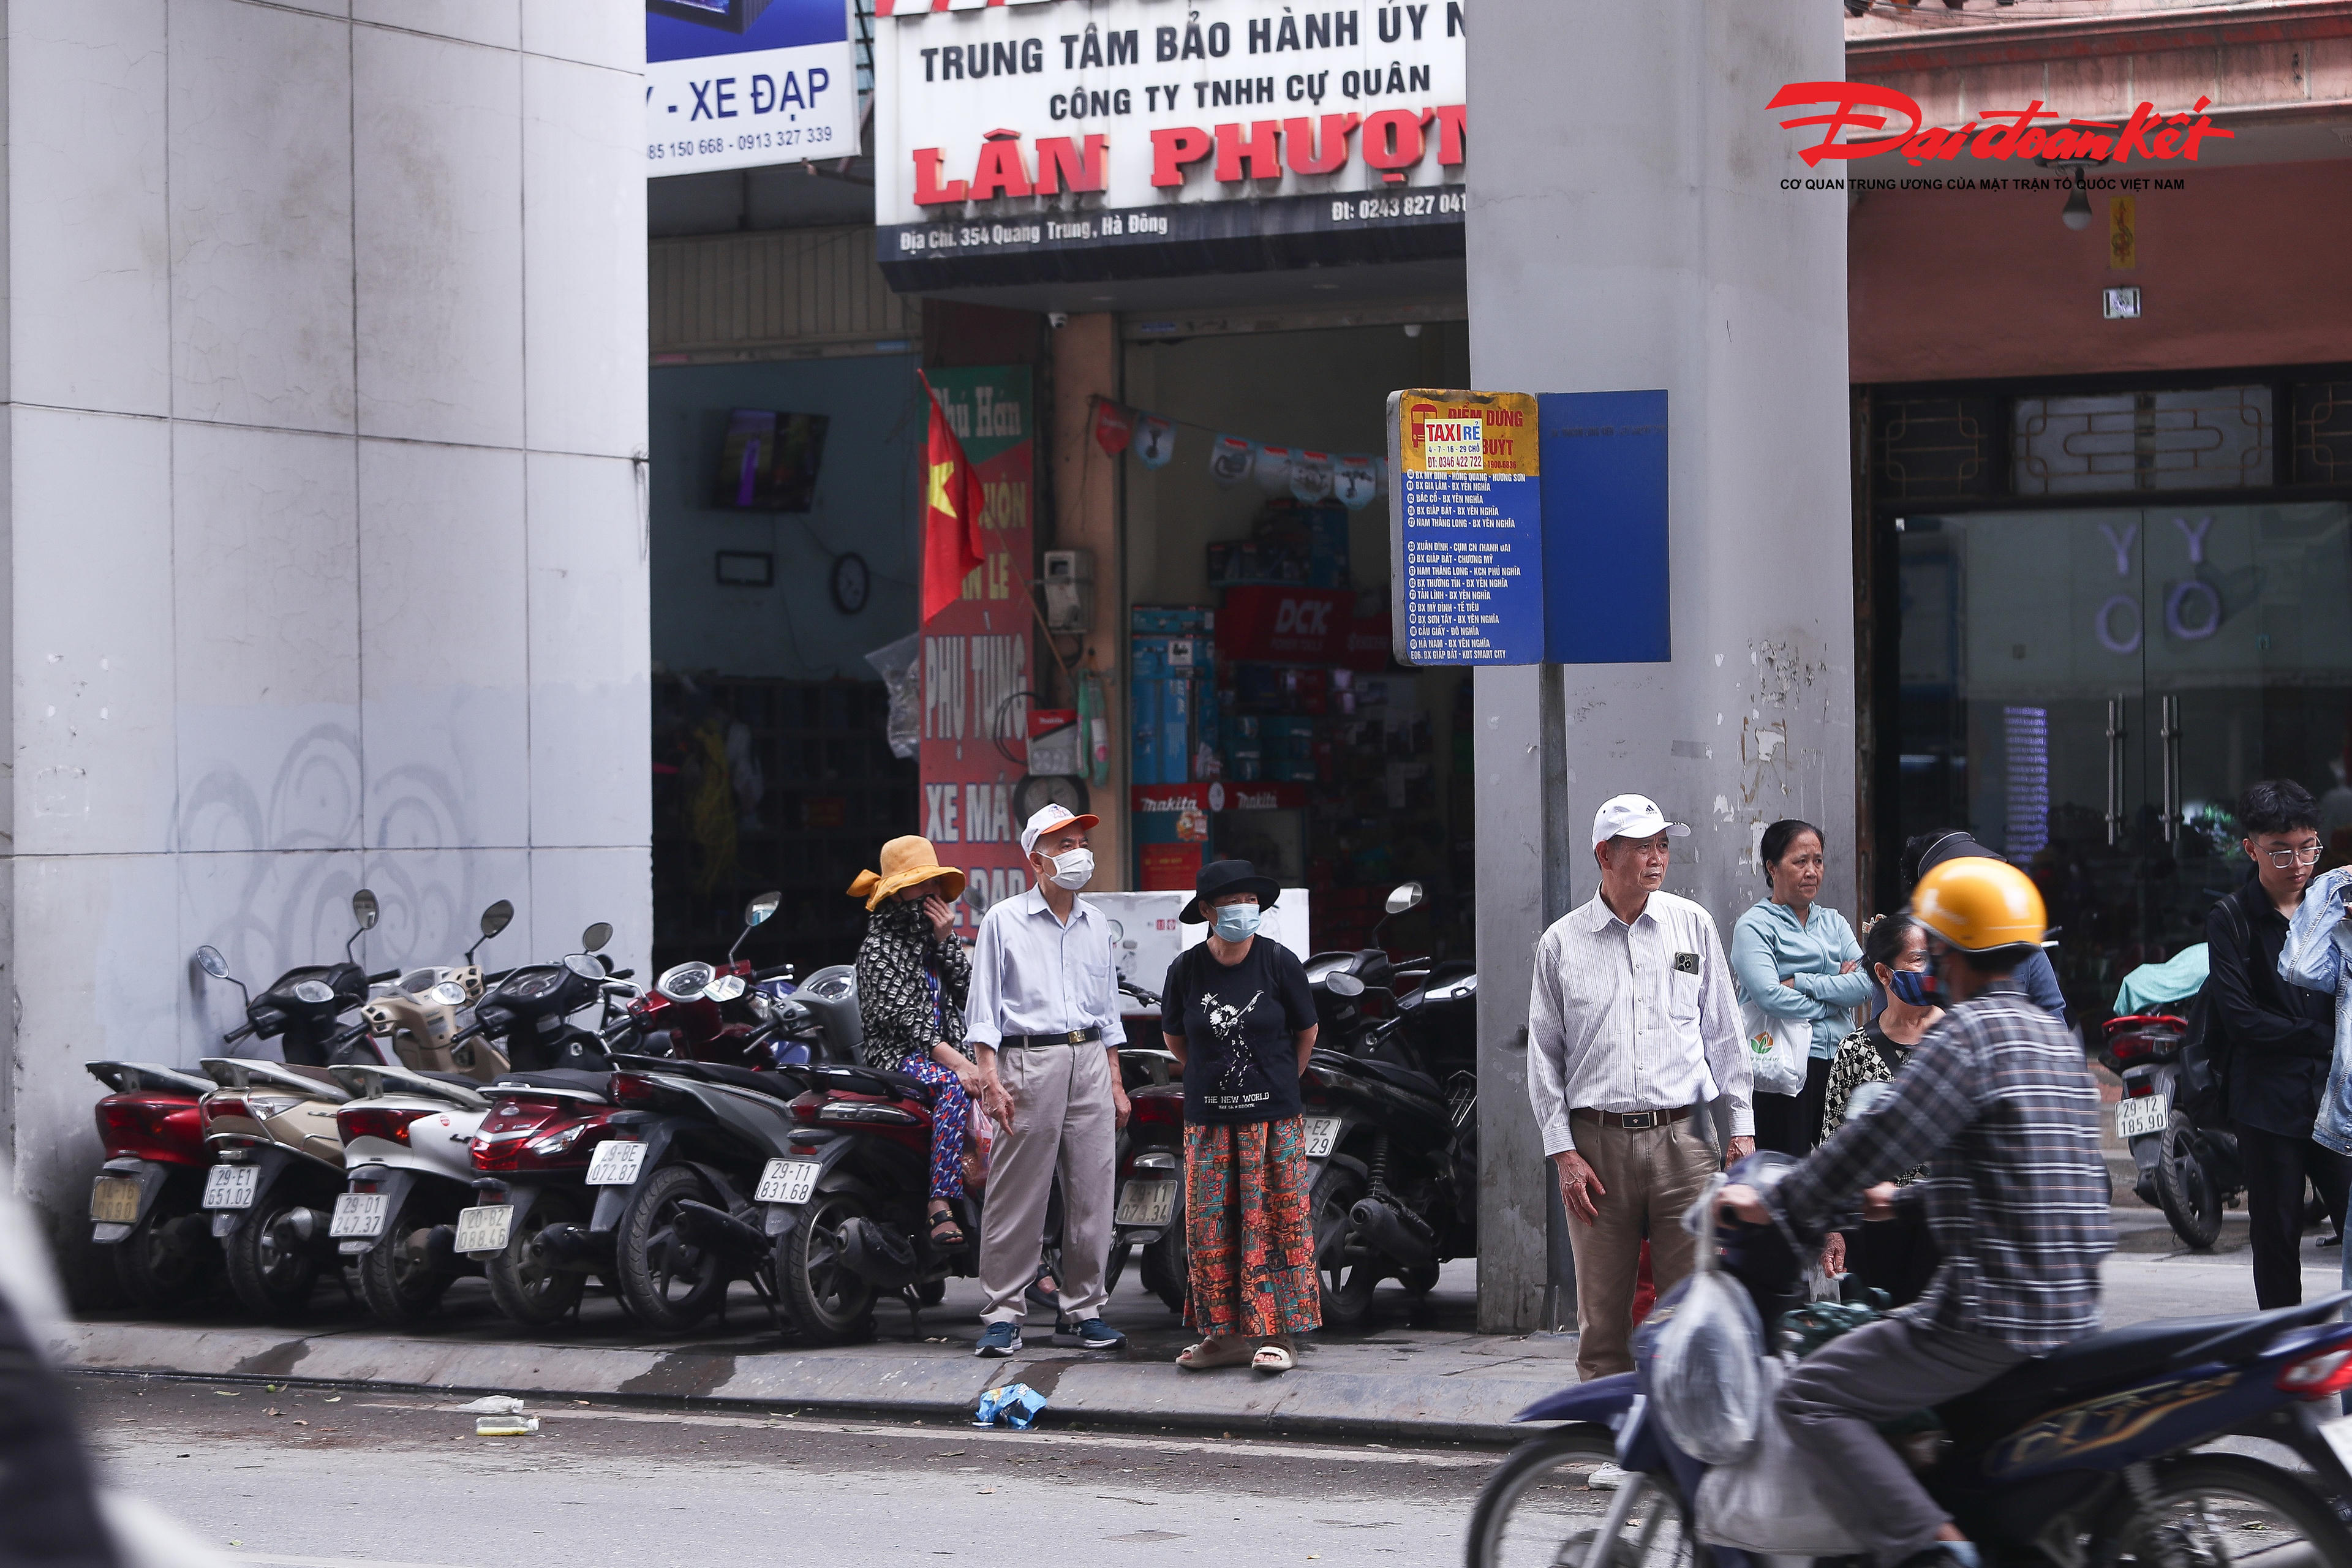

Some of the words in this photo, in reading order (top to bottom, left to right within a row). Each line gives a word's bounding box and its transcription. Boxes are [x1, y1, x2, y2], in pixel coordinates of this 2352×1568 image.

[921, 38, 1043, 82] TRUNG
[1060, 23, 1138, 69] TÂM
[1156, 10, 1230, 62] BẢO
[1250, 7, 1358, 55] HÀNH
[690, 78, 736, 121] XE
[751, 68, 830, 121] ĐẠP
[1050, 86, 1131, 120] CÔNG
[1145, 84, 1180, 113] TY
[1194, 77, 1275, 108] TNHH
[1286, 70, 1329, 105] CỰ
[1342, 61, 1431, 100] QUÂN
[671, 141, 693, 157] 150
[699, 138, 723, 154] 668
[738, 133, 772, 150] 0913
[777, 130, 801, 146] 327
[807, 126, 832, 143] 339
[913, 128, 1109, 205] LÂN
[1359, 198, 1400, 219] 0243
[1403, 195, 1435, 216] 827
[900, 232, 925, 255] Địa
[960, 227, 989, 246] 354
[992, 225, 1040, 246] Quang
[1047, 221, 1098, 240] Trung,
[1102, 216, 1123, 236] Hà
[1128, 213, 1167, 235] Đông
[1487, 406, 1523, 427] DỪNG
[1426, 424, 1461, 442] TAXI
[1463, 421, 1480, 440] RẺ
[1428, 457, 1438, 468] ĐT:
[1439, 456, 1455, 467] 0346
[1457, 456, 1468, 467] 422
[1470, 456, 1482, 467] 722
[1415, 481, 1423, 490] BX
[1425, 481, 1434, 490] GIA
[1435, 480, 1447, 491] LÂM
[1461, 480, 1472, 491] YÊN
[1473, 481, 1491, 491] NGHĨA
[1468, 473, 1488, 482] QUANG
[1442, 494, 1450, 503] BX
[1452, 492, 1463, 503] YÊN
[1464, 493, 1483, 504] NGHĨA
[1417, 507, 1425, 515] BX
[1427, 504, 1439, 515] GIÁP
[1441, 504, 1452, 515] BÁT
[1467, 505, 1479, 516] YÊN
[1480, 505, 1499, 516] NGHĨA
[1417, 518, 1430, 527] NAM
[1431, 516, 1450, 527] THĂNG
[1452, 519, 1468, 528] LONG
[1472, 519, 1481, 528] BX
[1482, 517, 1494, 528] YÊN
[1496, 518, 1515, 528] NGHĨA
[1417, 540, 1433, 551] XUÂN
[1453, 543, 1467, 553] CỤM
[1469, 543, 1477, 551] CN
[1426, 552, 1439, 564] GIÁP
[1441, 552, 1452, 564] BÁT
[1417, 567, 1431, 576] NAM
[1432, 565, 1451, 576] THĂNG
[1452, 567, 1468, 576] LONG
[1474, 567, 1487, 576] KCN
[1488, 565, 1500, 576] PHÚ
[1502, 565, 1521, 576] NGHĨA
[1476, 577, 1488, 588] YÊN
[1489, 577, 1508, 588] NGHĨA
[1458, 589, 1471, 600] YÊN
[1472, 589, 1491, 600] NGHĨA
[1438, 601, 1452, 612] ĐÌNH
[1466, 601, 1479, 612] TIÊU
[1427, 614, 1440, 624] SƠN
[1441, 613, 1452, 624] TÂY
[1467, 613, 1479, 624] YÊN
[1480, 613, 1499, 624] NGHĨA
[1431, 624, 1445, 636] GIẤY
[1460, 625, 1479, 636] NGHĨA
[1419, 637, 1427, 648] HÀ
[1428, 639, 1443, 648] NAM
[1458, 638, 1470, 648] YÊN
[1471, 638, 1490, 648] NGHĨA
[1433, 648, 1446, 659] GIÁP
[1447, 648, 1457, 659] BÁT
[1474, 650, 1493, 658] SMART
[1494, 650, 1506, 658] CITY
[925, 635, 967, 761] PHỤ
[971, 611, 1028, 740] TÙNG
[925, 783, 959, 843] XE
[1221, 1095, 1239, 1104] NEW
[1243, 1092, 1270, 1102] WORLD
[2121, 1113, 2163, 1135] 185.90
[601, 1145, 639, 1162] 29-BE
[592, 1164, 637, 1181] 072.87
[771, 1163, 811, 1182] 29-T1
[208, 1188, 252, 1205] 651.02
[760, 1181, 810, 1200] 831.68
[335, 1216, 380, 1234] 247.37
[459, 1229, 506, 1248] 088.46
